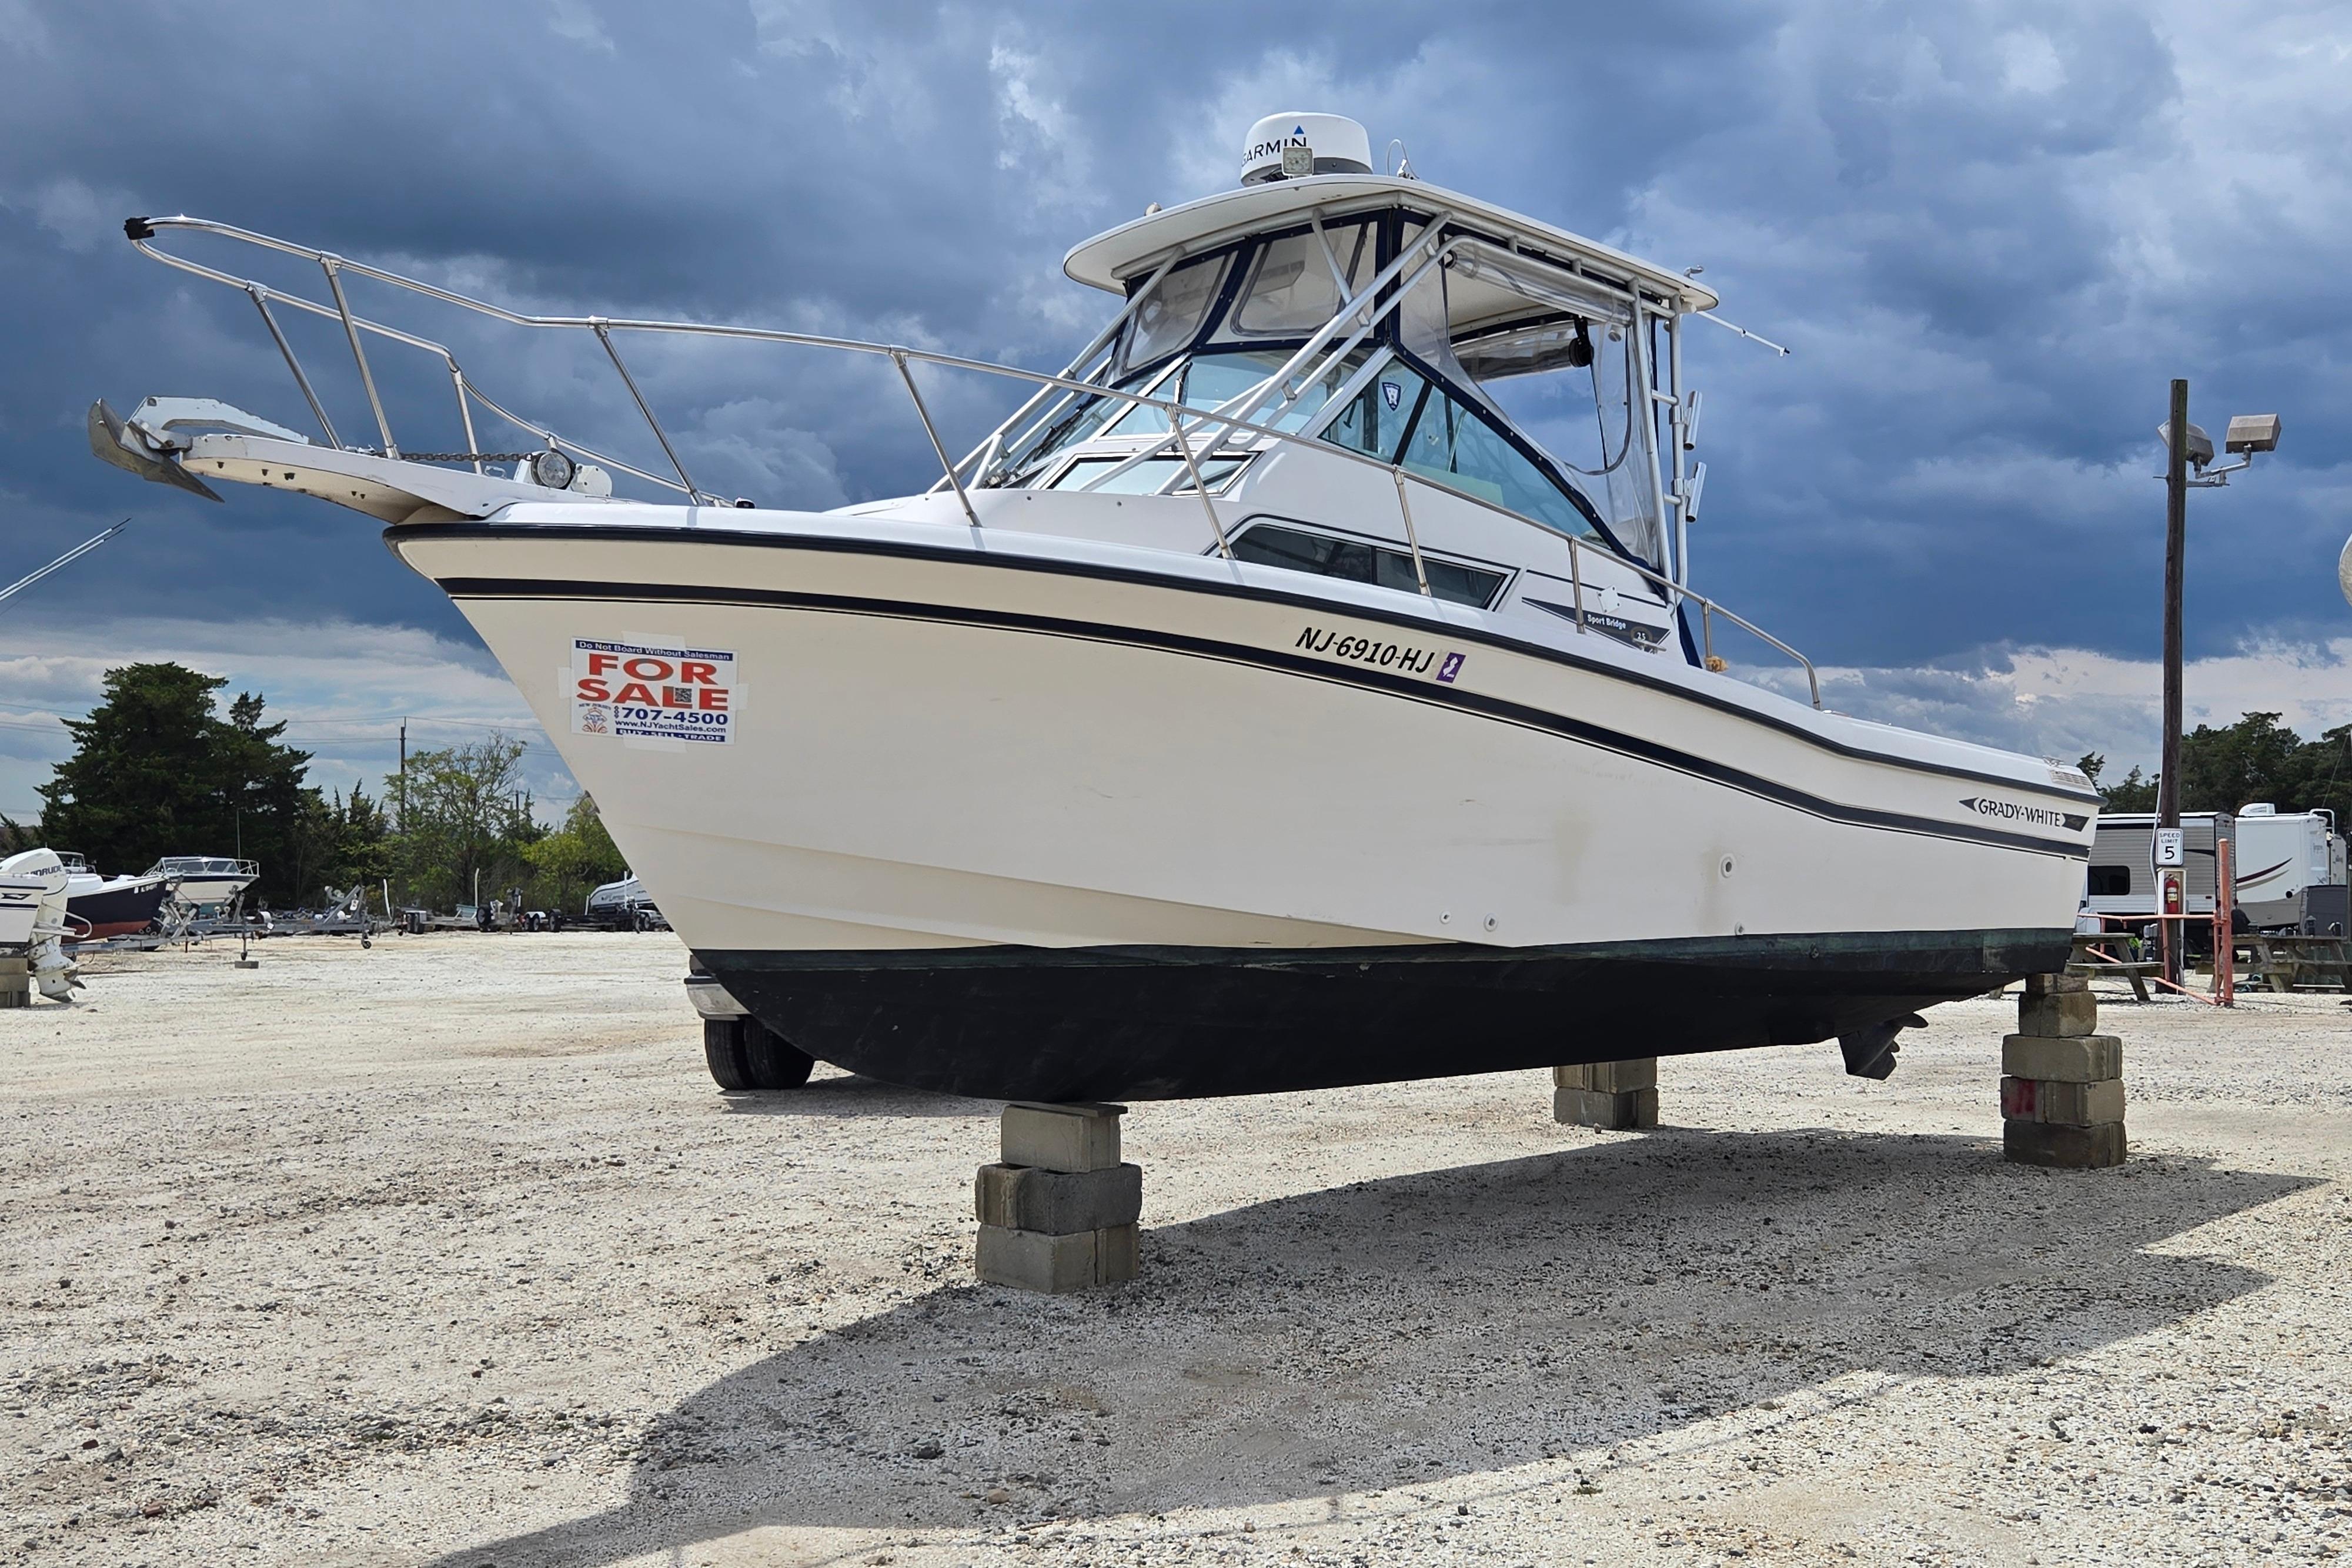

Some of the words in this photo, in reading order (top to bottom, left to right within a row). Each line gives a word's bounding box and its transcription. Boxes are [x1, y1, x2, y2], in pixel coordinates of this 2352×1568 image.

[1587, 614, 1605, 625] Sport
[1605, 617, 1626, 630] Bridge
[614, 645, 642, 654] Board
[646, 647, 681, 657] Without
[683, 650, 730, 660] Salesman
[1295, 627, 1435, 673] NJ-6910-HJ
[589, 653, 718, 685] FOR
[576, 678, 729, 711] SALE
[622, 707, 728, 725] 707-4500
[615, 720, 726, 733] www.NJYachtSales.com
[2164, 846, 2175, 860] 5
